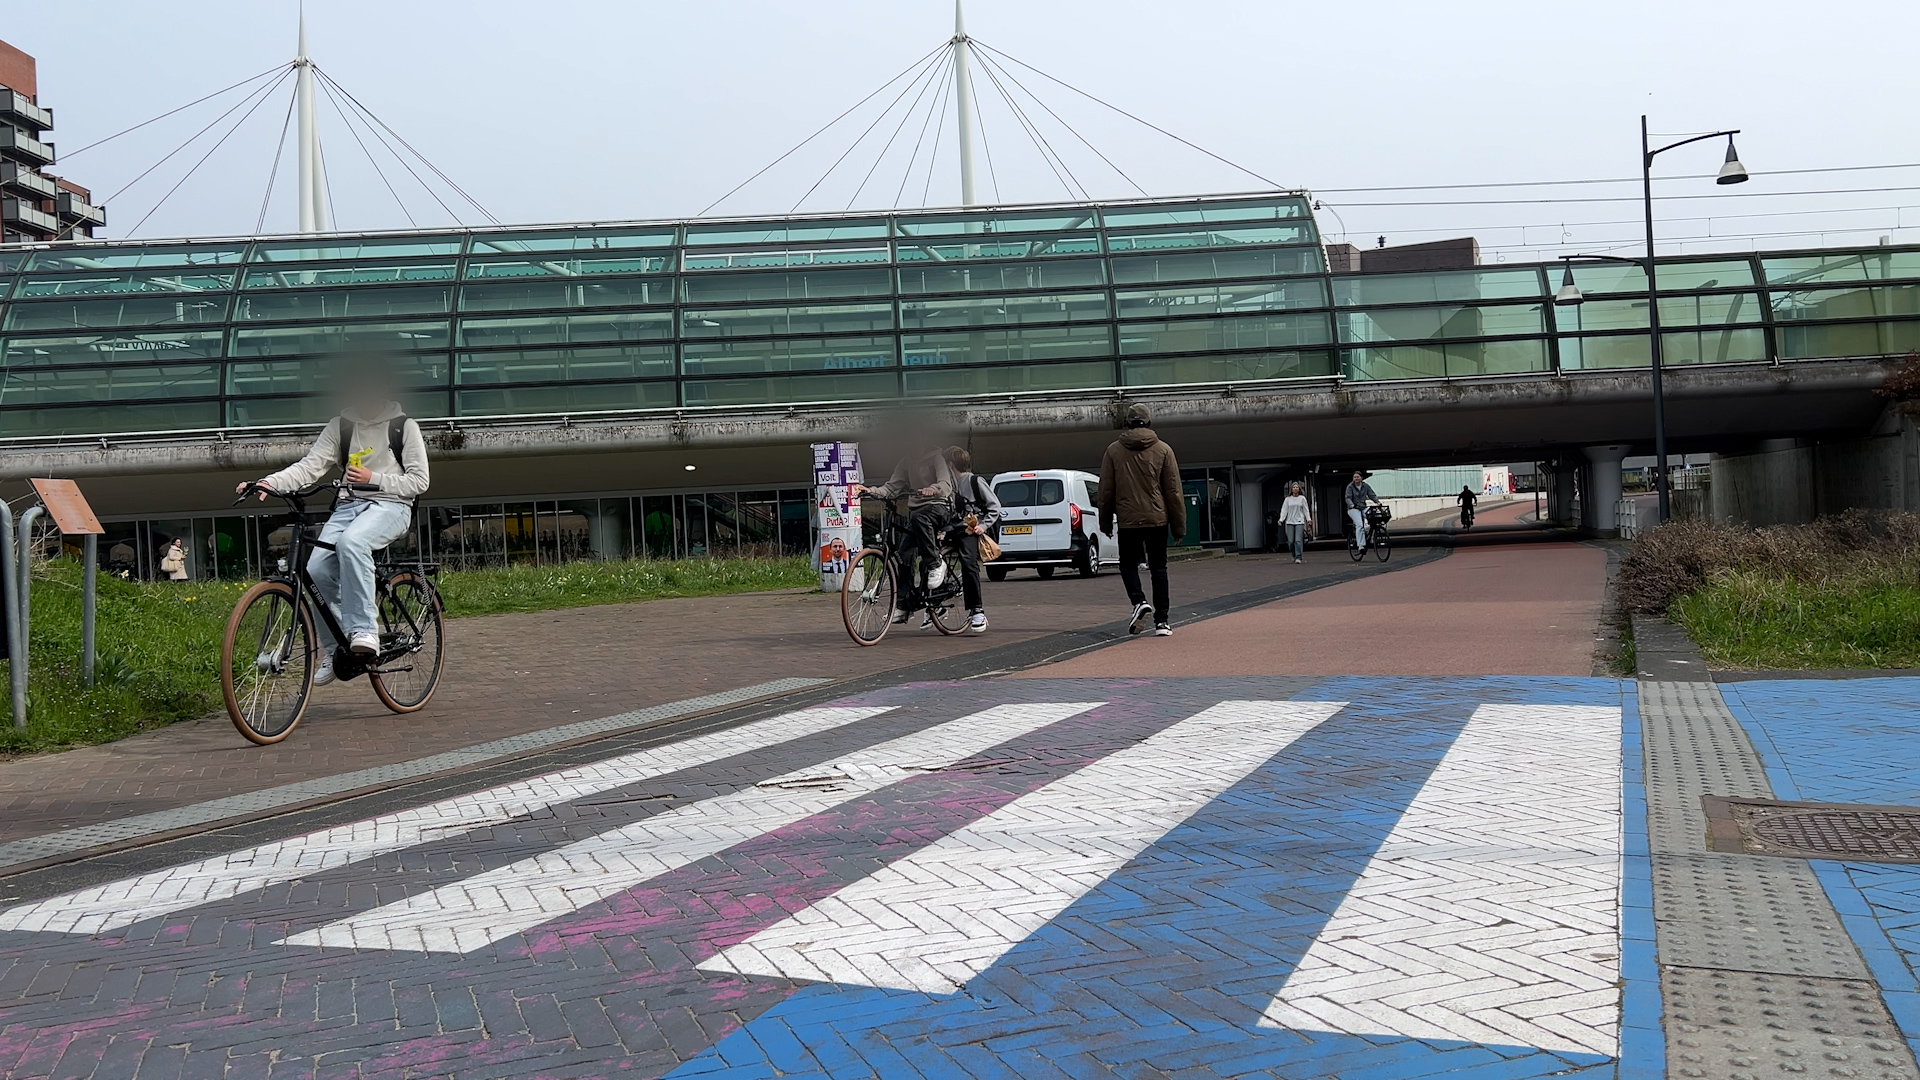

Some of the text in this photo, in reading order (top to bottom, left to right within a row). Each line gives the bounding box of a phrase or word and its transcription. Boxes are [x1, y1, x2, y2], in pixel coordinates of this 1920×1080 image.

[823, 355, 887, 369] Albert
[820, 472, 837, 482] Volt
[848, 472, 858, 481] Vol
